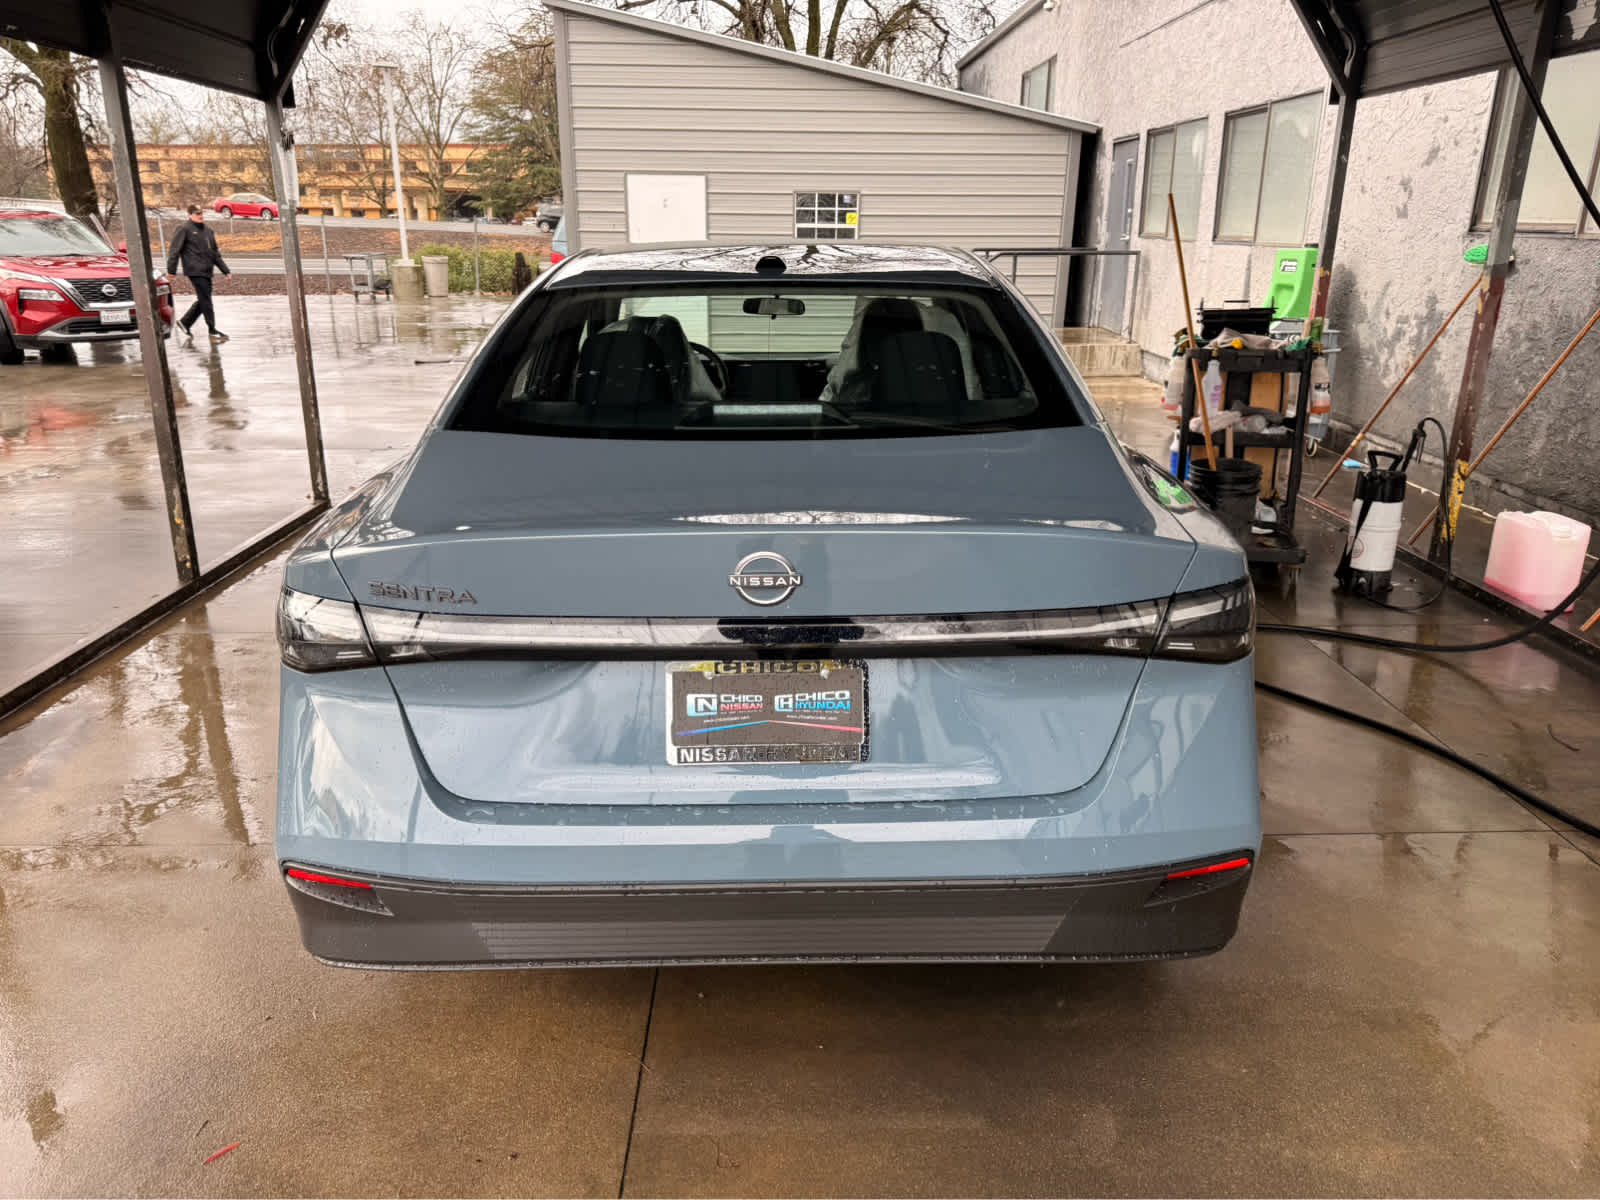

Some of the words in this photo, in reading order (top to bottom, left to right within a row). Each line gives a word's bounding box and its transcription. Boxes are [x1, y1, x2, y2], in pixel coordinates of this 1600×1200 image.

[729, 575, 801, 586] NISSAN
[368, 581, 478, 604] SENTRA
[717, 662, 818, 674] CHICO
[720, 693, 763, 703] CHICO
[795, 690, 851, 702] CHICO
[720, 702, 764, 712] NISSAN
[795, 700, 852, 711] HYUNDAI
